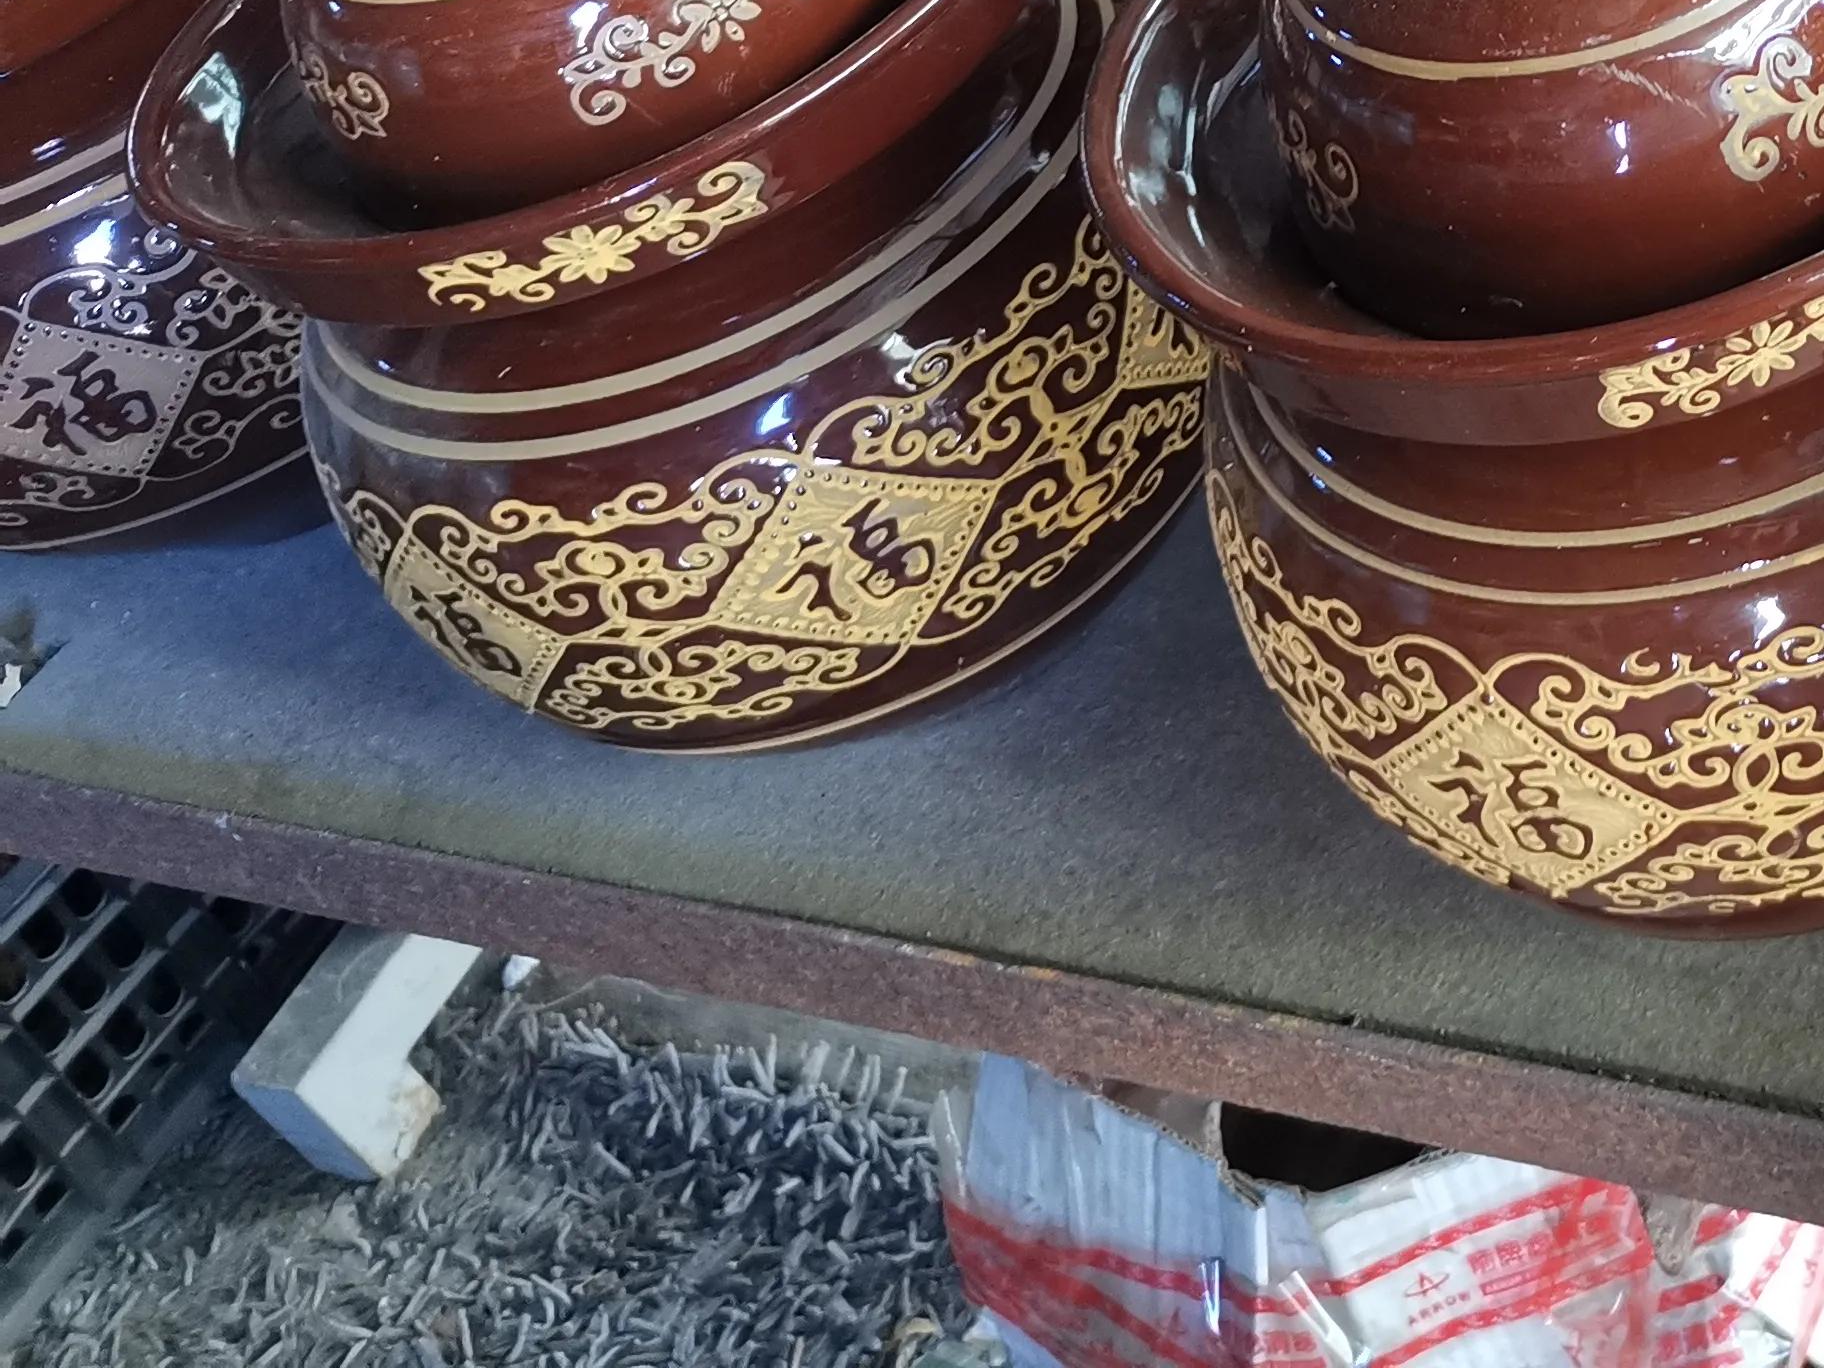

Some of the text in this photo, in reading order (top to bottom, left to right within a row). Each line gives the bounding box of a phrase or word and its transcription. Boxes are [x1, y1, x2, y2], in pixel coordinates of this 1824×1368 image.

[8, 349, 159, 458] 福
[774, 497, 938, 622] 福
[410, 584, 524, 678] 福
[1387, 747, 1594, 862] 福
